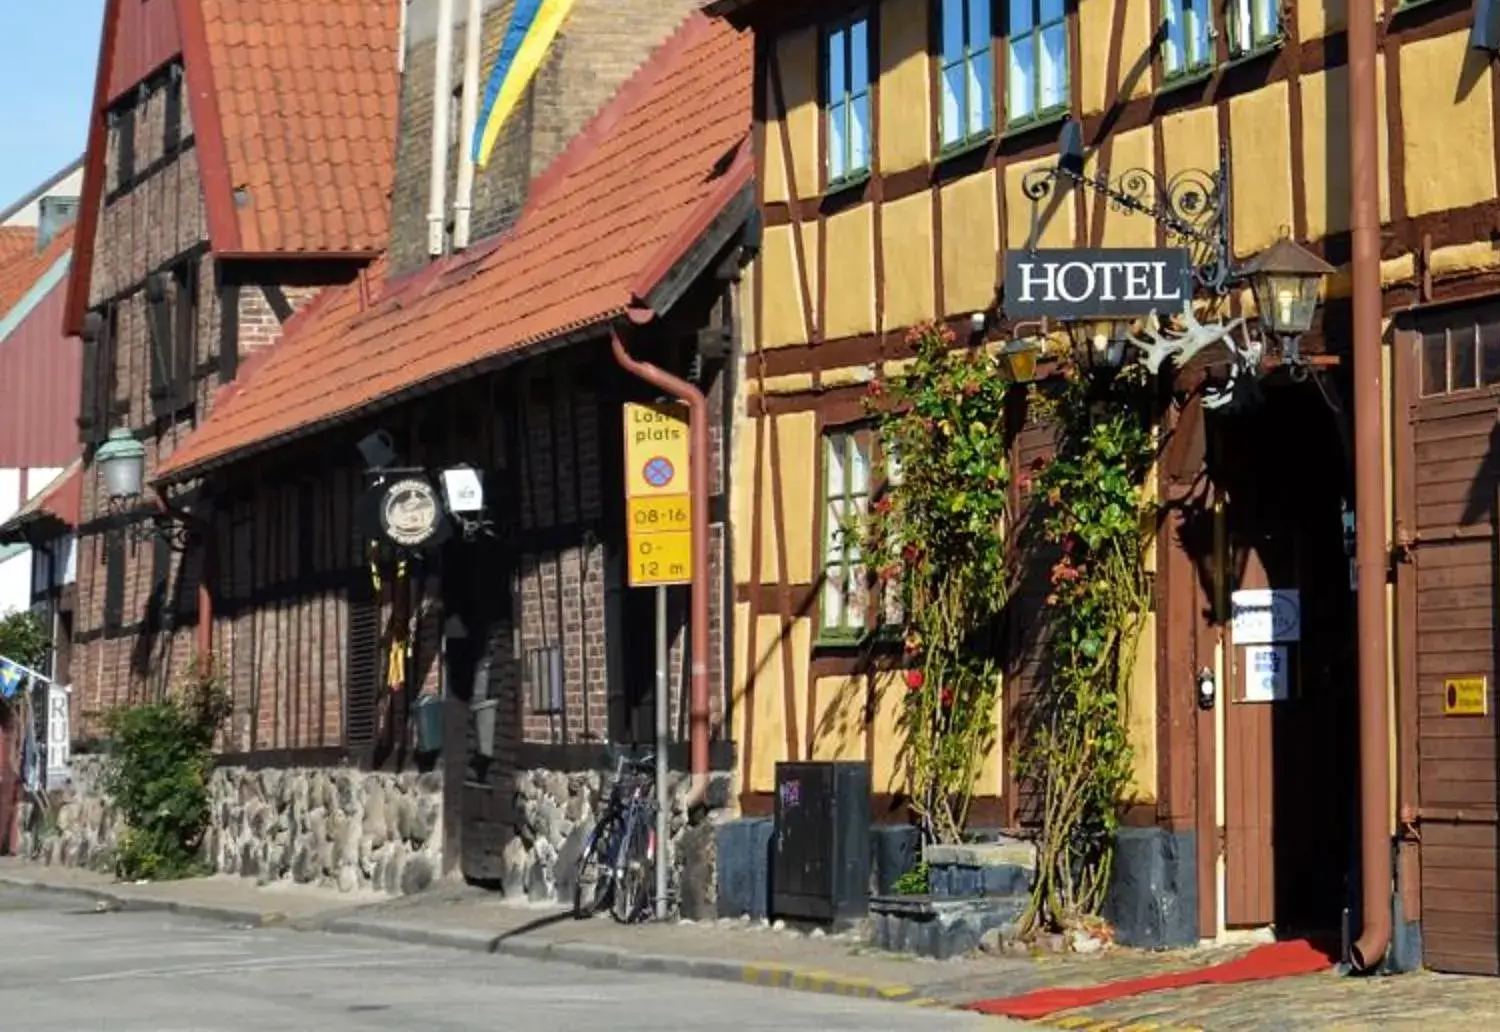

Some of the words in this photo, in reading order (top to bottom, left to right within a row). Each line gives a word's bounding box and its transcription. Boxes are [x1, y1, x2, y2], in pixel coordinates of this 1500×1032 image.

[1018, 261, 1181, 303] HOTEL
[636, 427, 681, 444] plats
[635, 508, 687, 524] 08-16
[640, 561, 659, 577] 12
[669, 564, 684, 576] m
